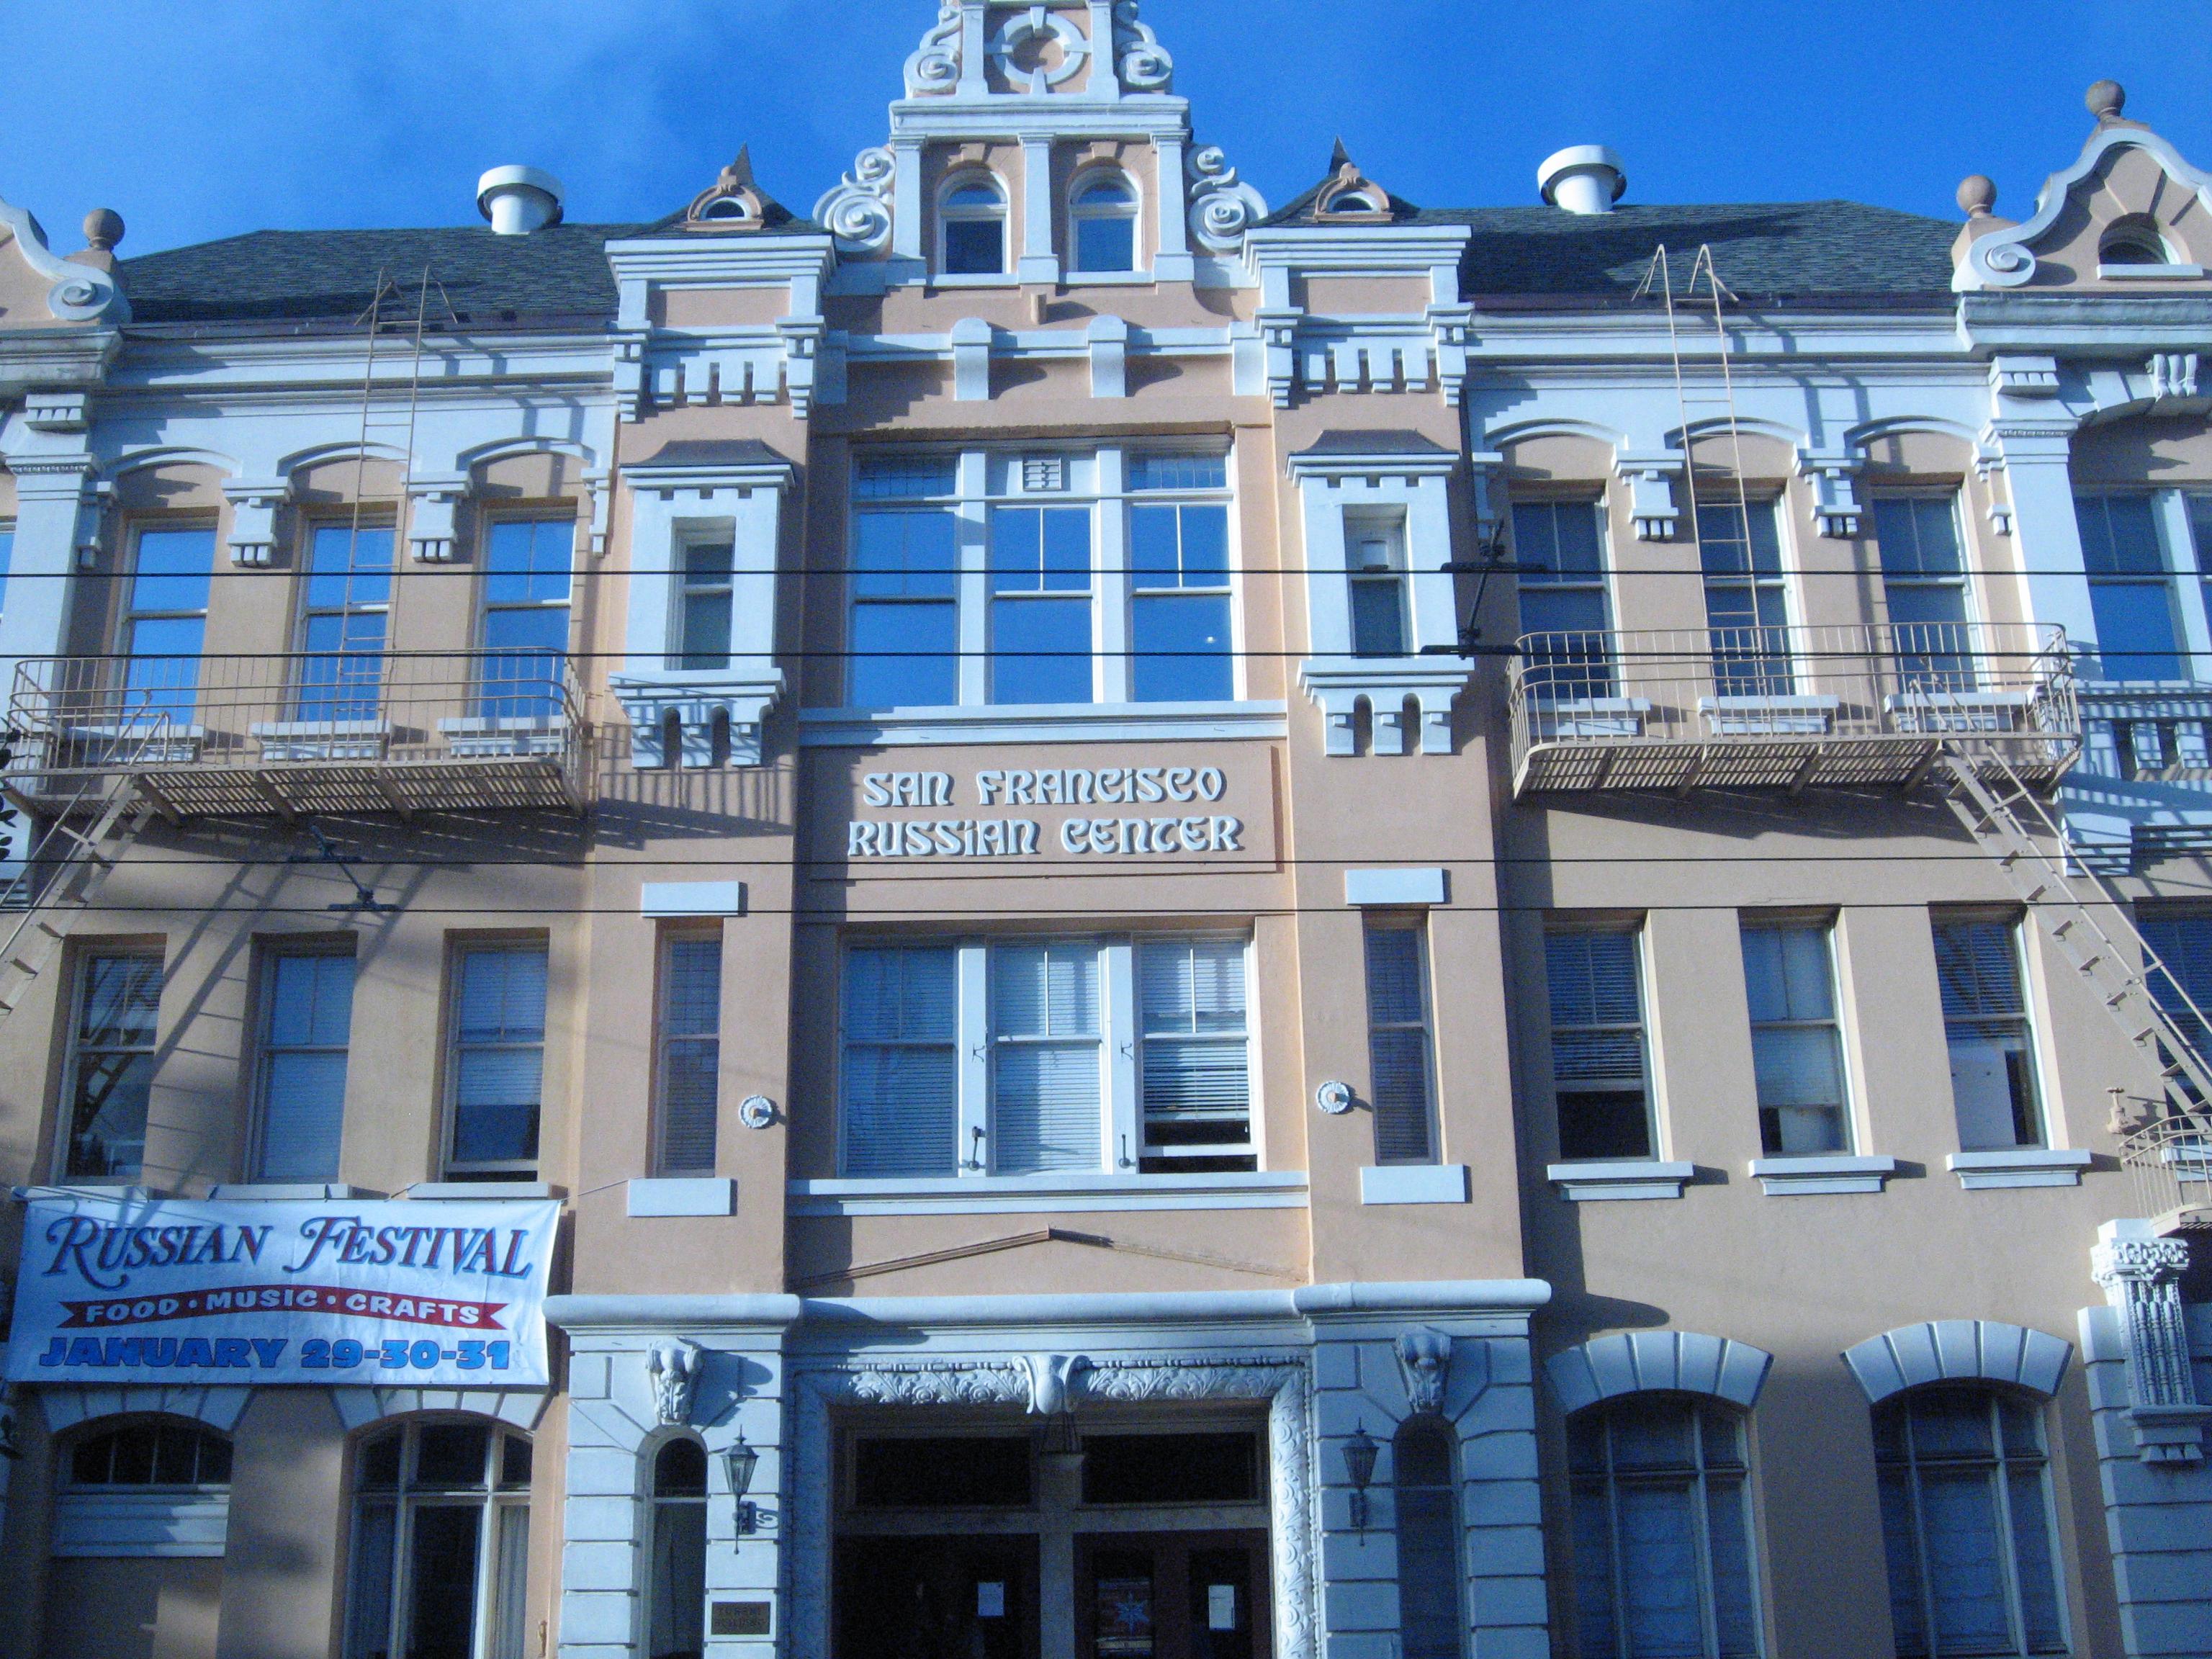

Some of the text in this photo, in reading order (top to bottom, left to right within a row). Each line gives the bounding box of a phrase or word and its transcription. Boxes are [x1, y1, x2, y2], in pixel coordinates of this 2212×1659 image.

[863, 767, 1226, 807] SAN FRANCISCO
[848, 815, 1242, 857] RUSSIAN CENTER
[42, 1215, 534, 1290] RUSSIAN FESTIVAL
[84, 1290, 481, 1323] FOOD MUSIC CRAFTS
[39, 1337, 511, 1369] JANUARY 29-30-31
